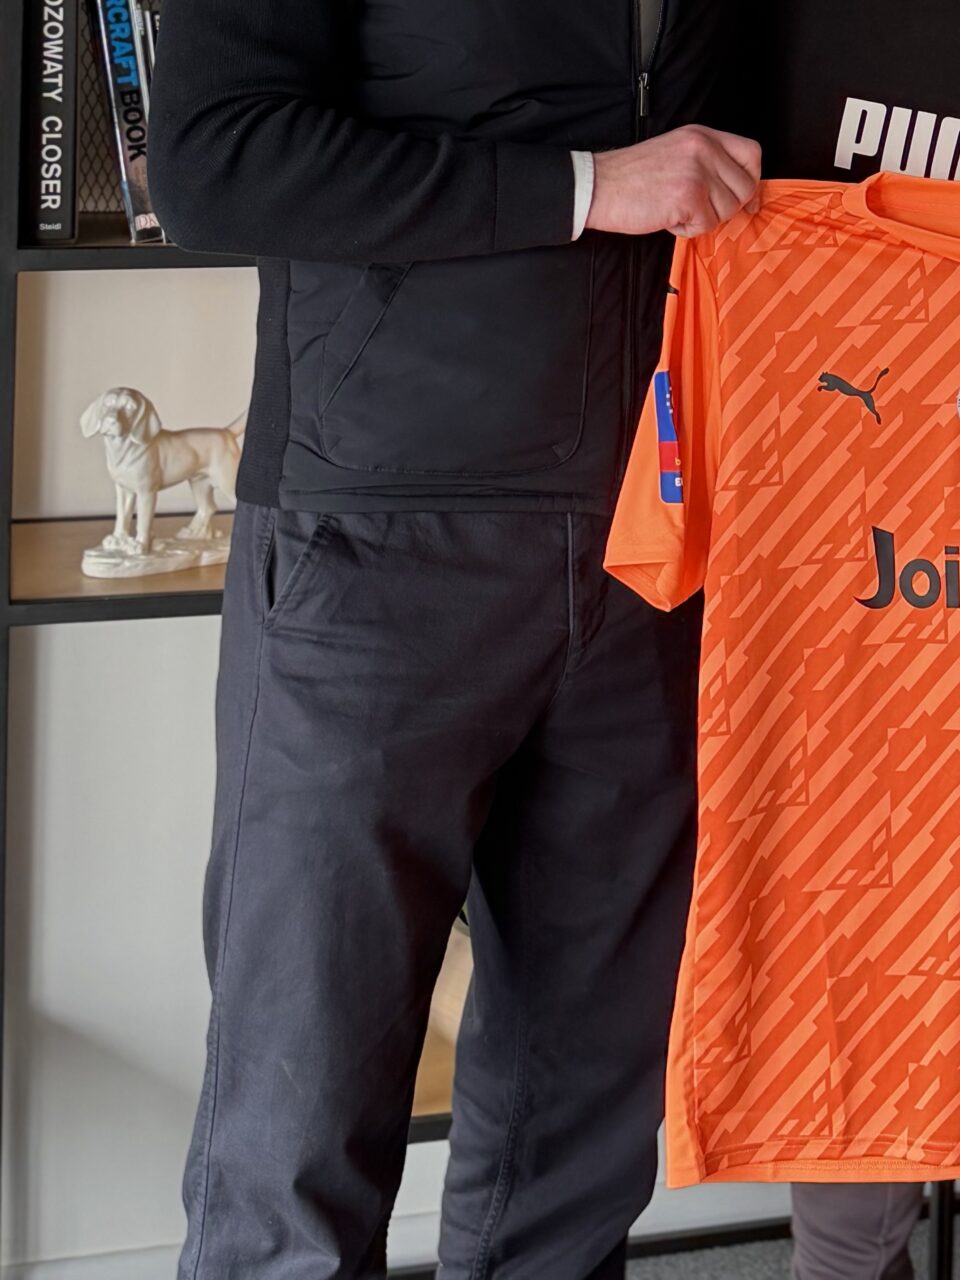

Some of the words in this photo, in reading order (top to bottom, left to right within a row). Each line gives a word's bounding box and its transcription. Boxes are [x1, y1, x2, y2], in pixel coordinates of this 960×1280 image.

[121, 90, 148, 162] BOOK
[40, 115, 63, 210] CLOSER
[39, 222, 62, 231] Steidl
